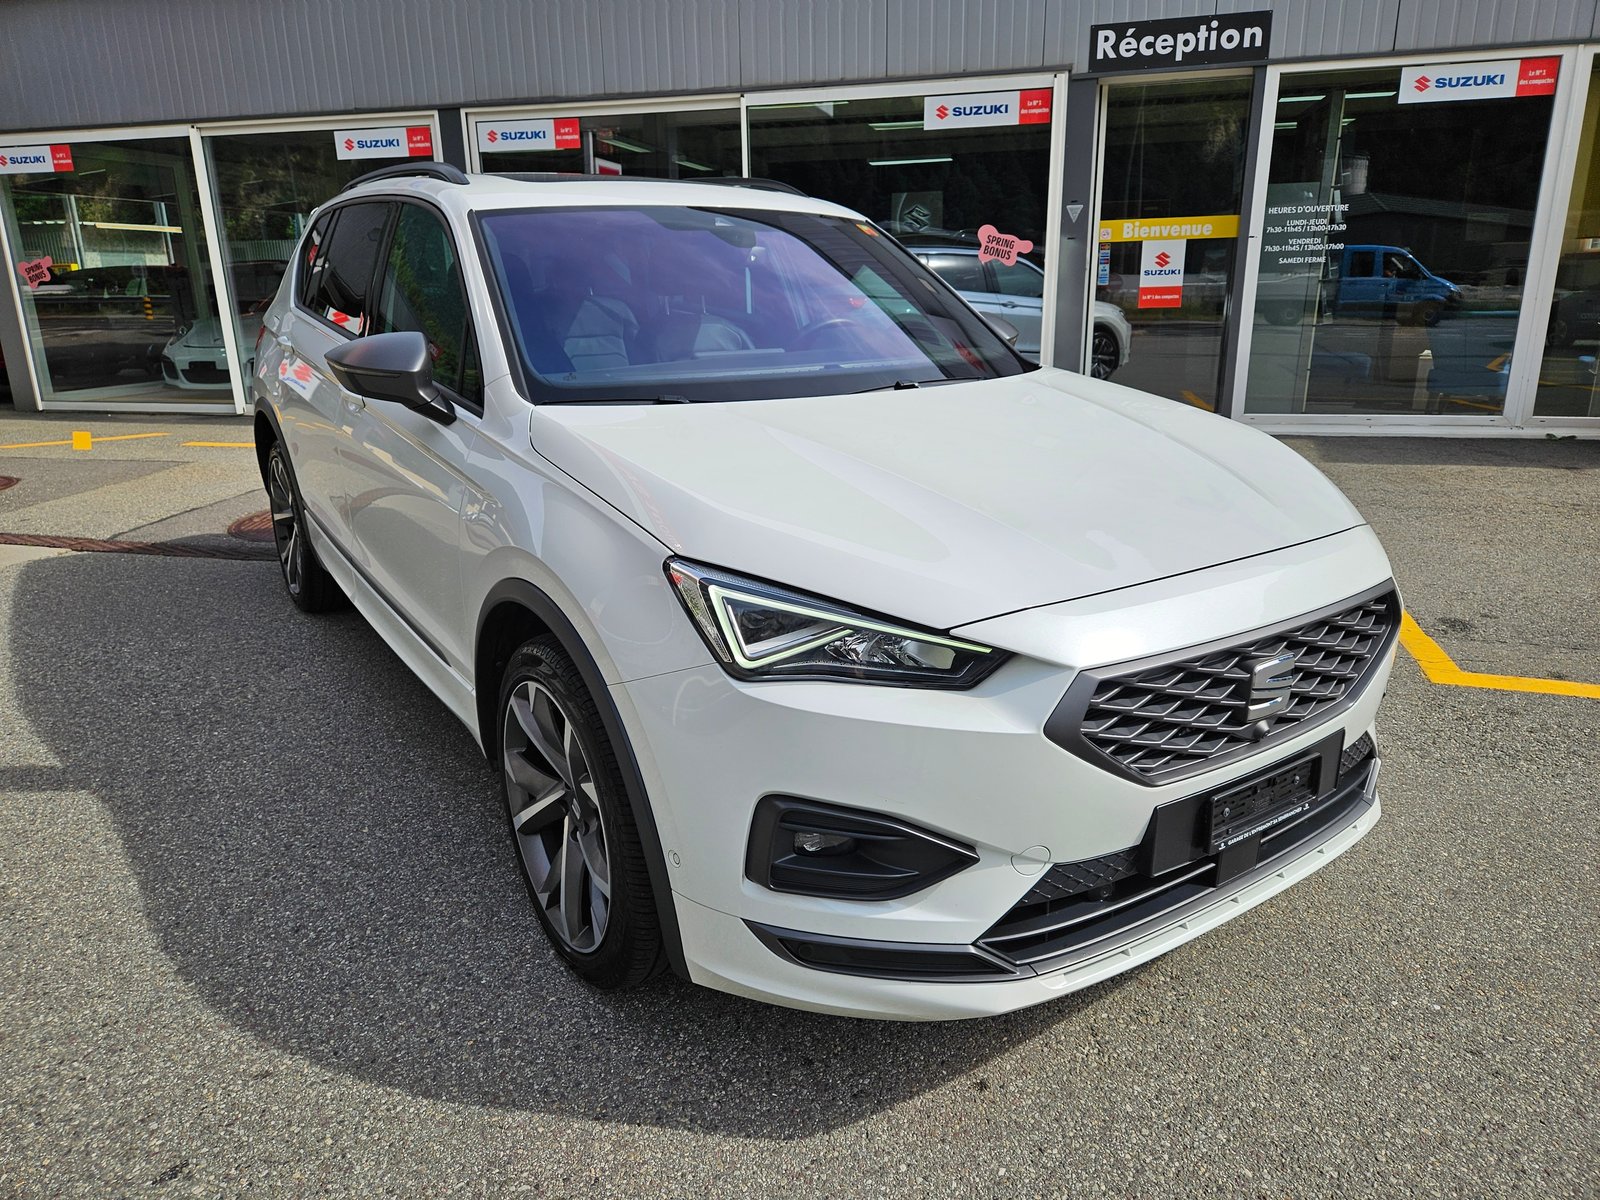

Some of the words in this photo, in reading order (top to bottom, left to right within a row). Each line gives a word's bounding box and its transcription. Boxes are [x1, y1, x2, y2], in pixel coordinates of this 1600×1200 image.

[1096, 20, 1263, 62] Réception
[1434, 74, 1505, 89] SUZUKI
[952, 104, 1009, 117] SUZUKI
[500, 130, 547, 142] SUZUKI
[356, 138, 400, 150] SUZUKI
[9, 155, 46, 165] SUZUKI
[1268, 206, 1297, 214] HEURES
[1297, 204, 1349, 213] D'OUVERTURE
[1122, 221, 1213, 239] Bienvenue
[1307, 224, 1347, 232] 13h00-17h30
[986, 234, 1015, 249] SPRING
[1288, 237, 1322, 245] VENDREDI
[1304, 243, 1345, 251] 13h00-17h00
[983, 245, 1012, 260] BONUS
[25, 263, 43, 275] SPRING
[1143, 269, 1181, 277] SUZUKI
[29, 271, 47, 283] BONUS
